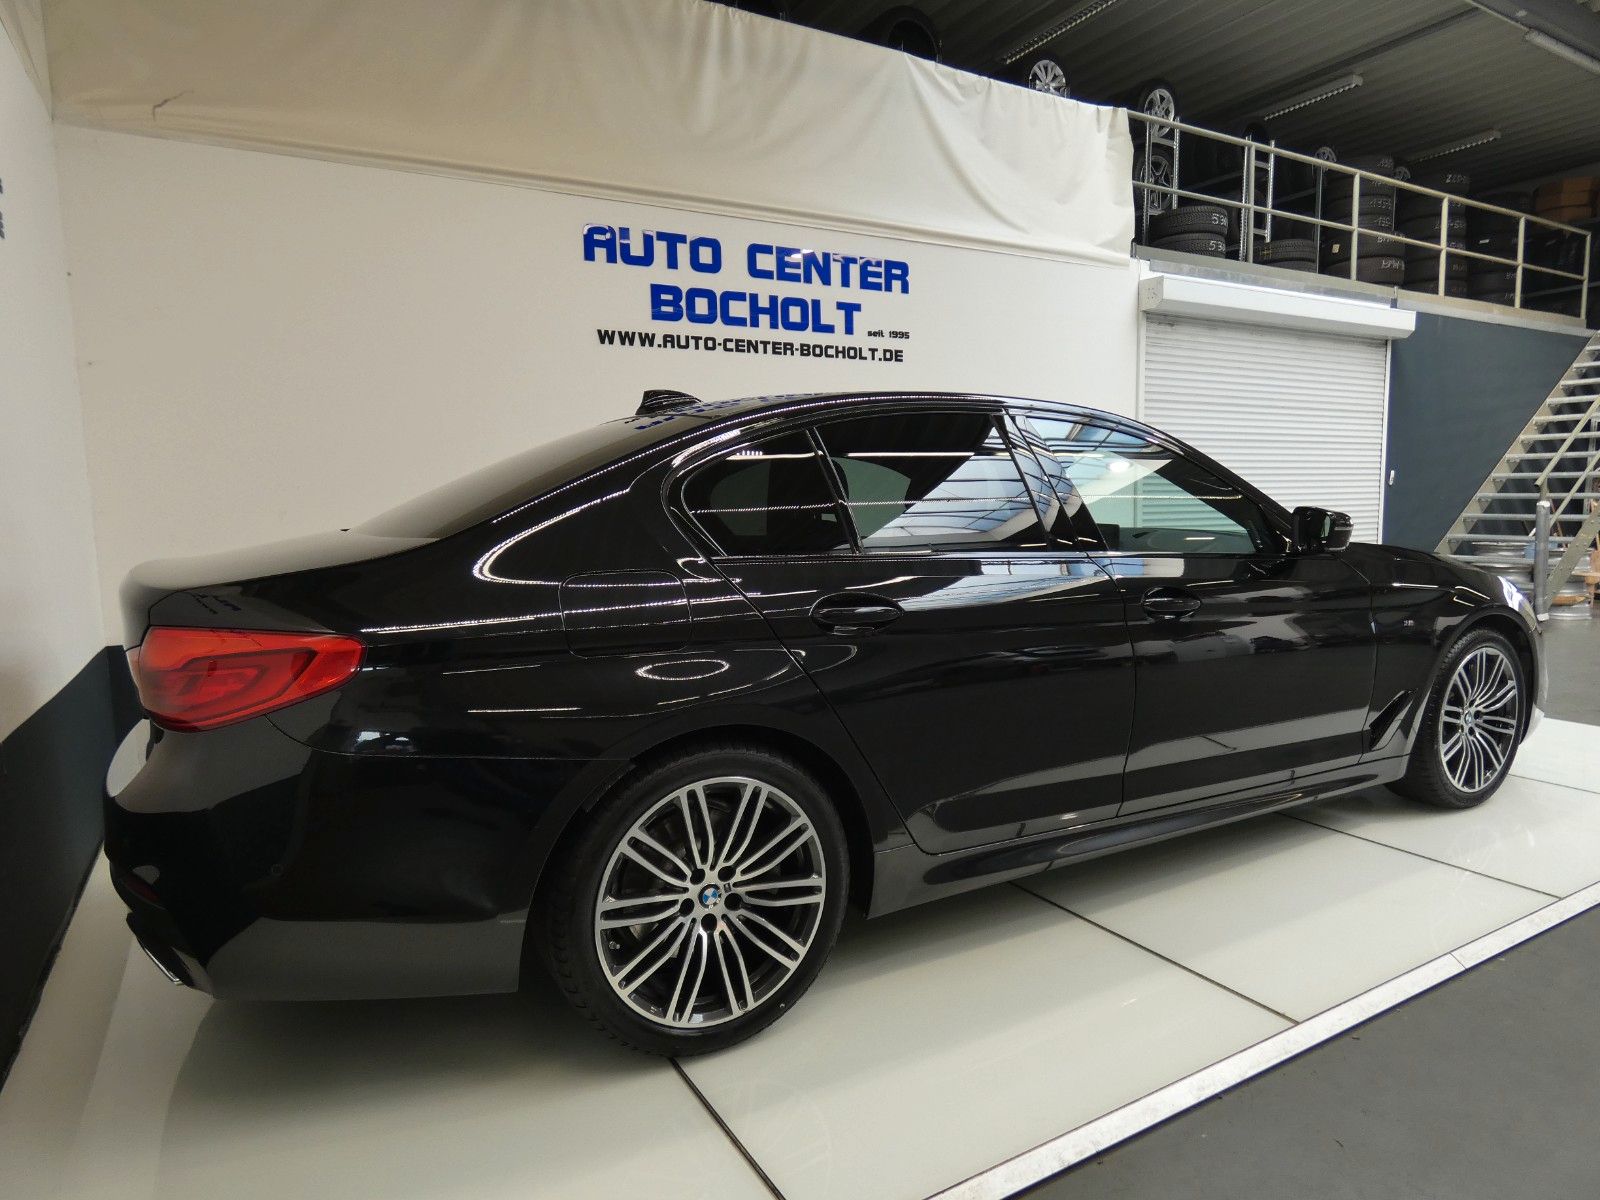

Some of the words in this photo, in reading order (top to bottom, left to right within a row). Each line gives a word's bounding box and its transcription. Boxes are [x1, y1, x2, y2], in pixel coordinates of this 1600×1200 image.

[583, 224, 722, 273] AUTO
[747, 243, 910, 294] CENTER
[650, 283, 862, 335] BOCHOLT
[596, 328, 904, 363] WWW.AUTO-CENTER-BOCHOLT.DE
[867, 329, 885, 338] seit
[888, 330, 910, 340] 1995
